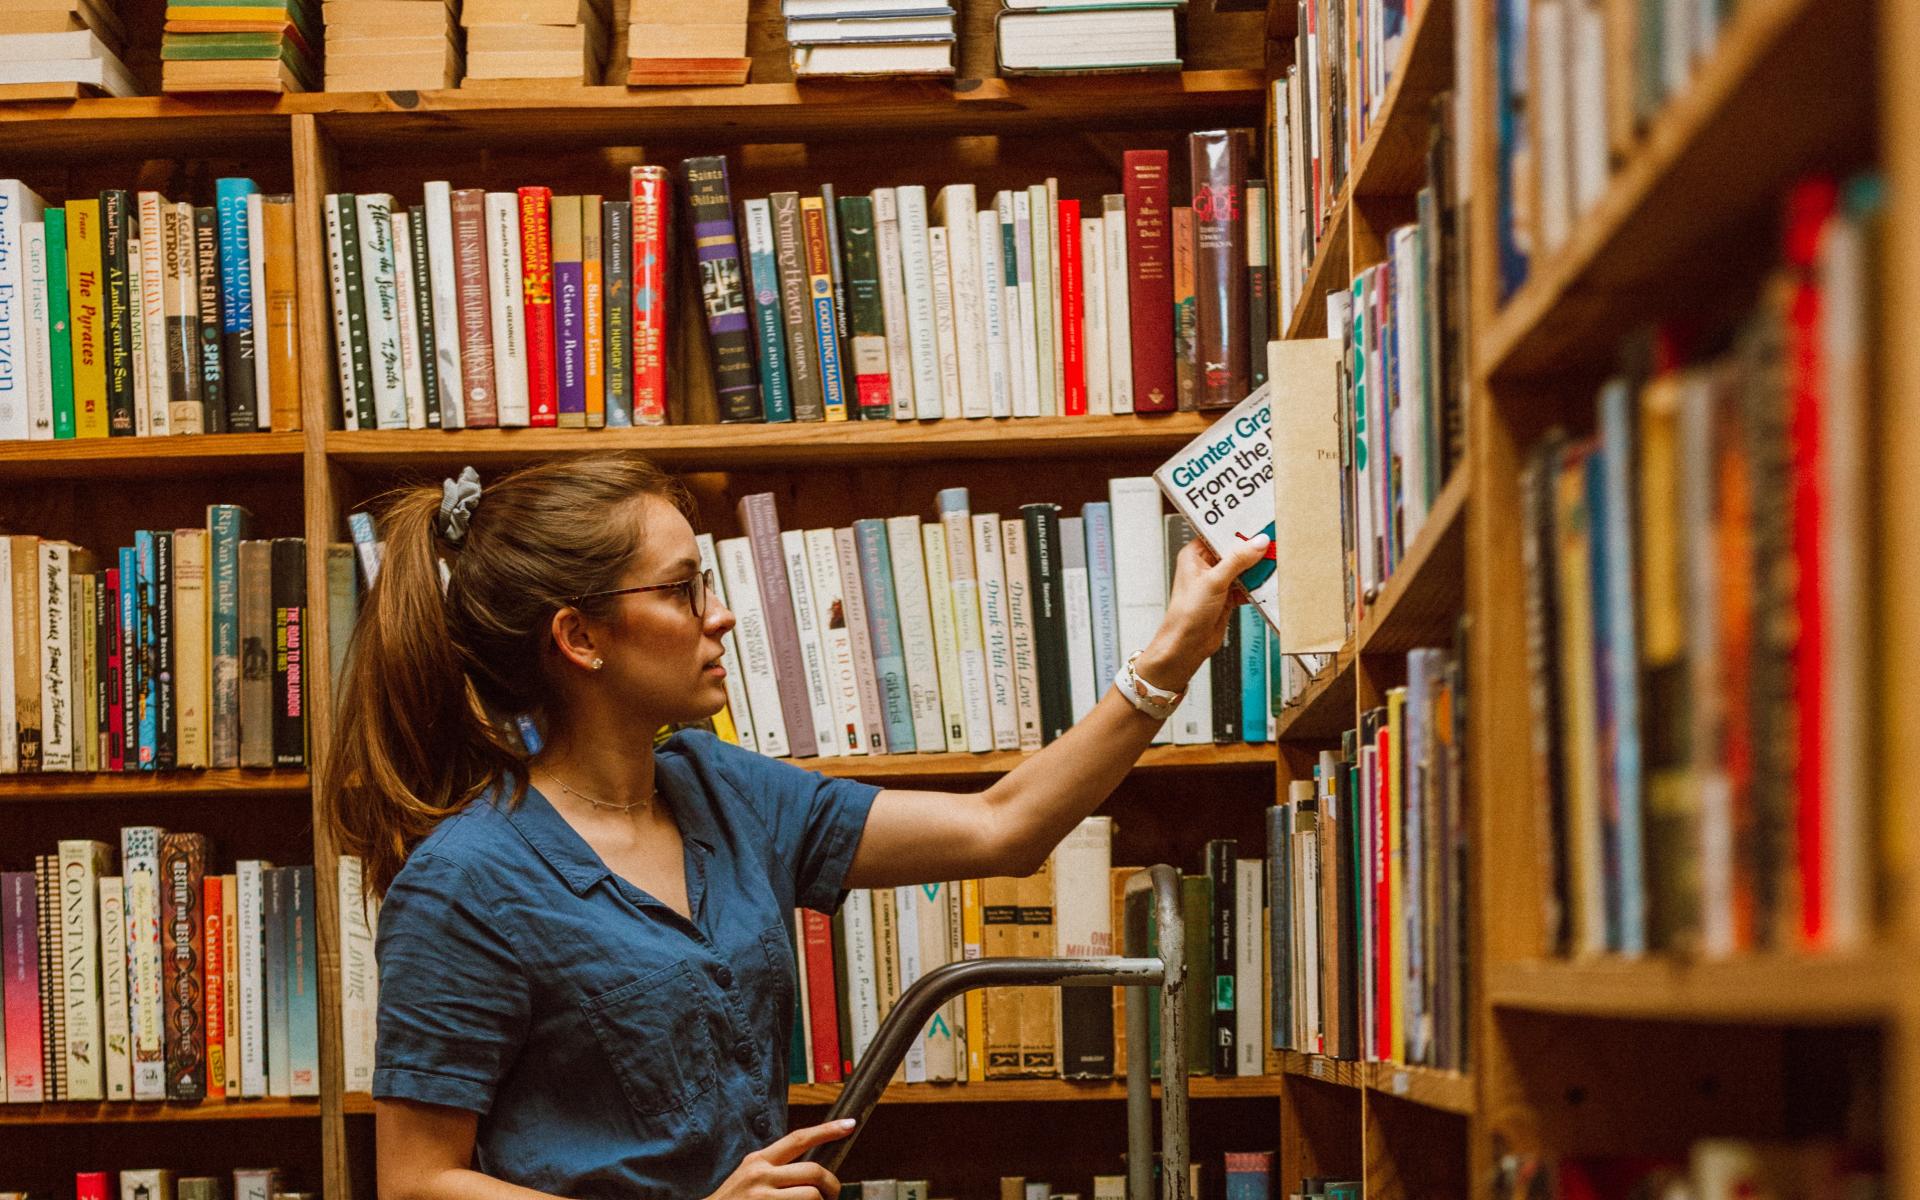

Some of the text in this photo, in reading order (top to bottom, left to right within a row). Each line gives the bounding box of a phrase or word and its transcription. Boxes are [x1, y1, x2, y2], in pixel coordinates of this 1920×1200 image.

[688, 169, 723, 182] Saints
[79, 211, 89, 239] Fraser
[107, 195, 119, 255] Michael Frayn
[141, 199, 156, 269] MICHAEL
[178, 213, 191, 277] AGAINST
[328, 210, 336, 239] THE
[459, 219, 478, 241] THE
[523, 195, 537, 270] CHROMOSOME
[537, 195, 549, 271] THE CALCUTTA
[612, 211, 622, 274] AMITAV GHOSH
[634, 195, 646, 243] GHOSH
[30, 238, 43, 273] Caro
[166, 213, 180, 280] ENTROPY
[221, 197, 236, 327] CHARLES FRAZIER
[414, 211, 430, 327] EXTRAORDINARY PEOPLE
[774, 197, 805, 324] Storming Heaven
[32, 278, 46, 321] Fraser
[129, 273, 140, 294] THE
[143, 270, 161, 318] FRAYN
[199, 228, 217, 324] MICHAEL FRAYN
[233, 196, 254, 360] COLD MOUNTAIN
[331, 252, 342, 295] BOOK
[986, 262, 1000, 337] ELLEN FOSTER
[78, 270, 97, 366] The Pyrates
[110, 267, 128, 392] A Landing on the Sun
[130, 297, 141, 317] TIN
[337, 309, 344, 327] OF
[343, 207, 368, 420] SYLVIE GERMAIN
[563, 284, 575, 327] Circle
[587, 283, 599, 335] Shadow
[936, 282, 950, 333] GIBBONS
[132, 320, 143, 350] MEN
[588, 338, 600, 376] Lines
[610, 306, 622, 396] THE HUNGRY TIDE
[634, 320, 647, 374] Poppies
[793, 331, 808, 381] GIARDINA
[818, 300, 840, 402] GOOD KING HARRY
[919, 329, 932, 382] GIBBONS
[204, 344, 220, 381] SPIES
[565, 339, 577, 388] Reason
[1172, 403, 1272, 488] Günter Gra
[1186, 442, 1270, 509] From the
[1204, 499, 1226, 527] of
[1224, 493, 1241, 510] a
[215, 510, 234, 615] Rip Van Winkle
[841, 538, 854, 567] Ellen
[981, 521, 993, 553] Gilchrist
[1007, 523, 1019, 555] Gilchrist
[1037, 515, 1050, 577] ELLEN GILCHRIST
[1094, 514, 1107, 572] GILCHRIST
[158, 536, 169, 669] Columbus Slaughters Braves
[287, 607, 300, 623] THE
[1100, 595, 1113, 661] DANGEROUS
[288, 625, 300, 649] ROAD
[288, 650, 300, 663] TO
[985, 579, 1009, 707] Drunk With Love
[1009, 581, 1033, 709] Drunk With Love
[124, 592, 135, 749] COLUMBUS SLAUGHTERS BRAVES
[834, 637, 856, 714] RHODA
[964, 650, 982, 720] Ellen Gilchrist
[885, 671, 903, 725] Gilchrist
[912, 683, 924, 720] Gilchrist
[925, 690, 937, 711] Ellen
[172, 861, 188, 905] DESTINY
[65, 861, 87, 1010] CONSTANCIA
[175, 921, 190, 961] DESIRE
[242, 870, 254, 978] The Crystal Frontier
[1091, 931, 1112, 945] ONE
[1222, 910, 1230, 921] The
[105, 897, 121, 1007] CONSTANCIA
[141, 952, 151, 992] CARLOS
[207, 914, 222, 1038] CARLOS FUENTES
[179, 969, 190, 1007] CARLOS
[227, 979, 236, 1038] CARLOS FUENTES
[142, 994, 154, 1043] FUENTES
[211, 1049, 225, 1083] USED
